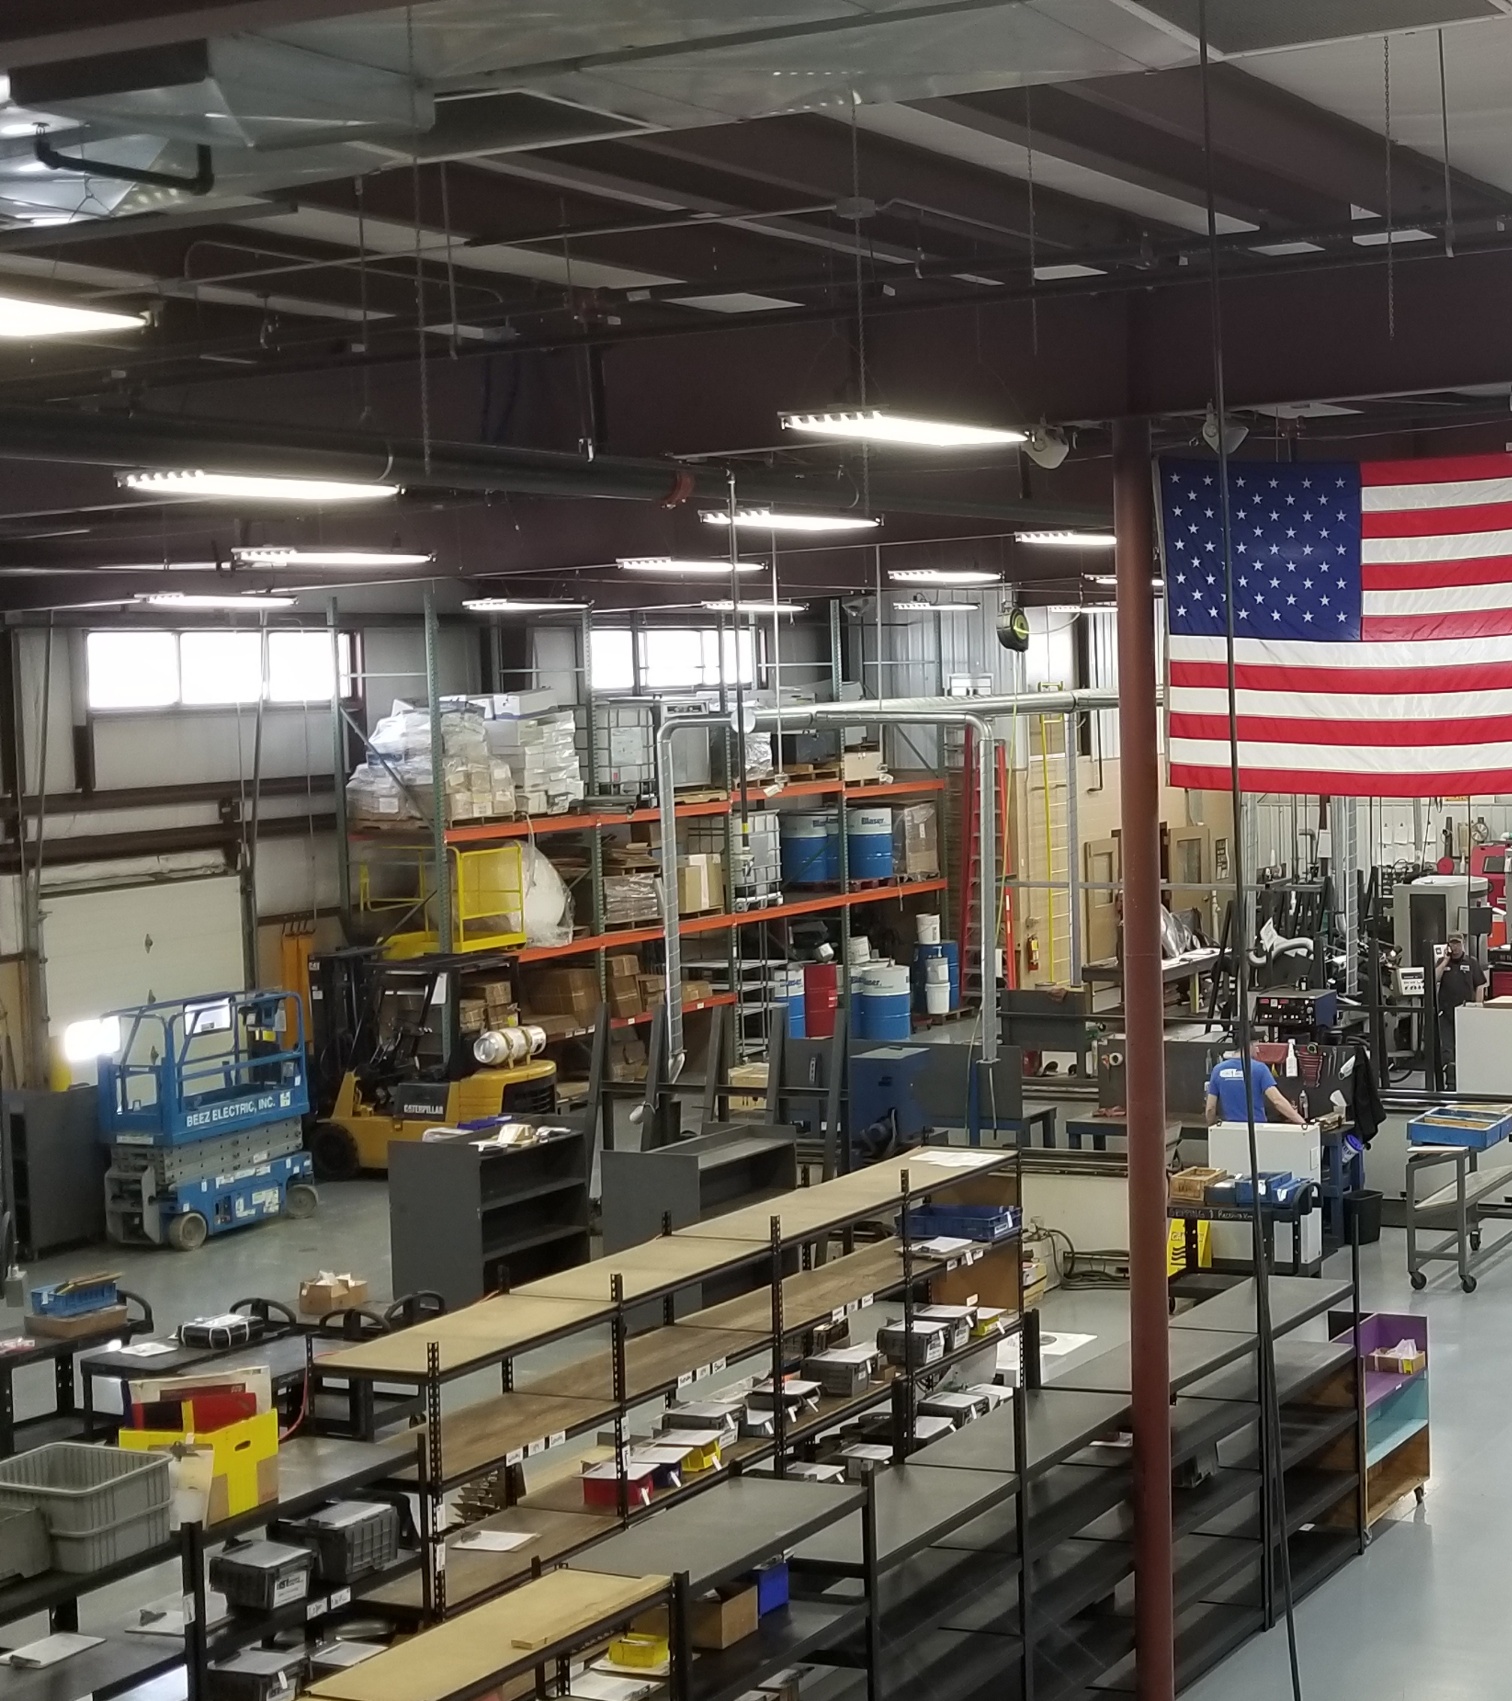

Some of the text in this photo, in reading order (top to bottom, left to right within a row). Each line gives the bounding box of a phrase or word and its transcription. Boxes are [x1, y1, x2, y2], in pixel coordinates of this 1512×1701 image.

[186, 1096, 276, 1127] BEEZ ELECTRIC, INC.
[403, 1104, 444, 1115] CATERPILLAR
